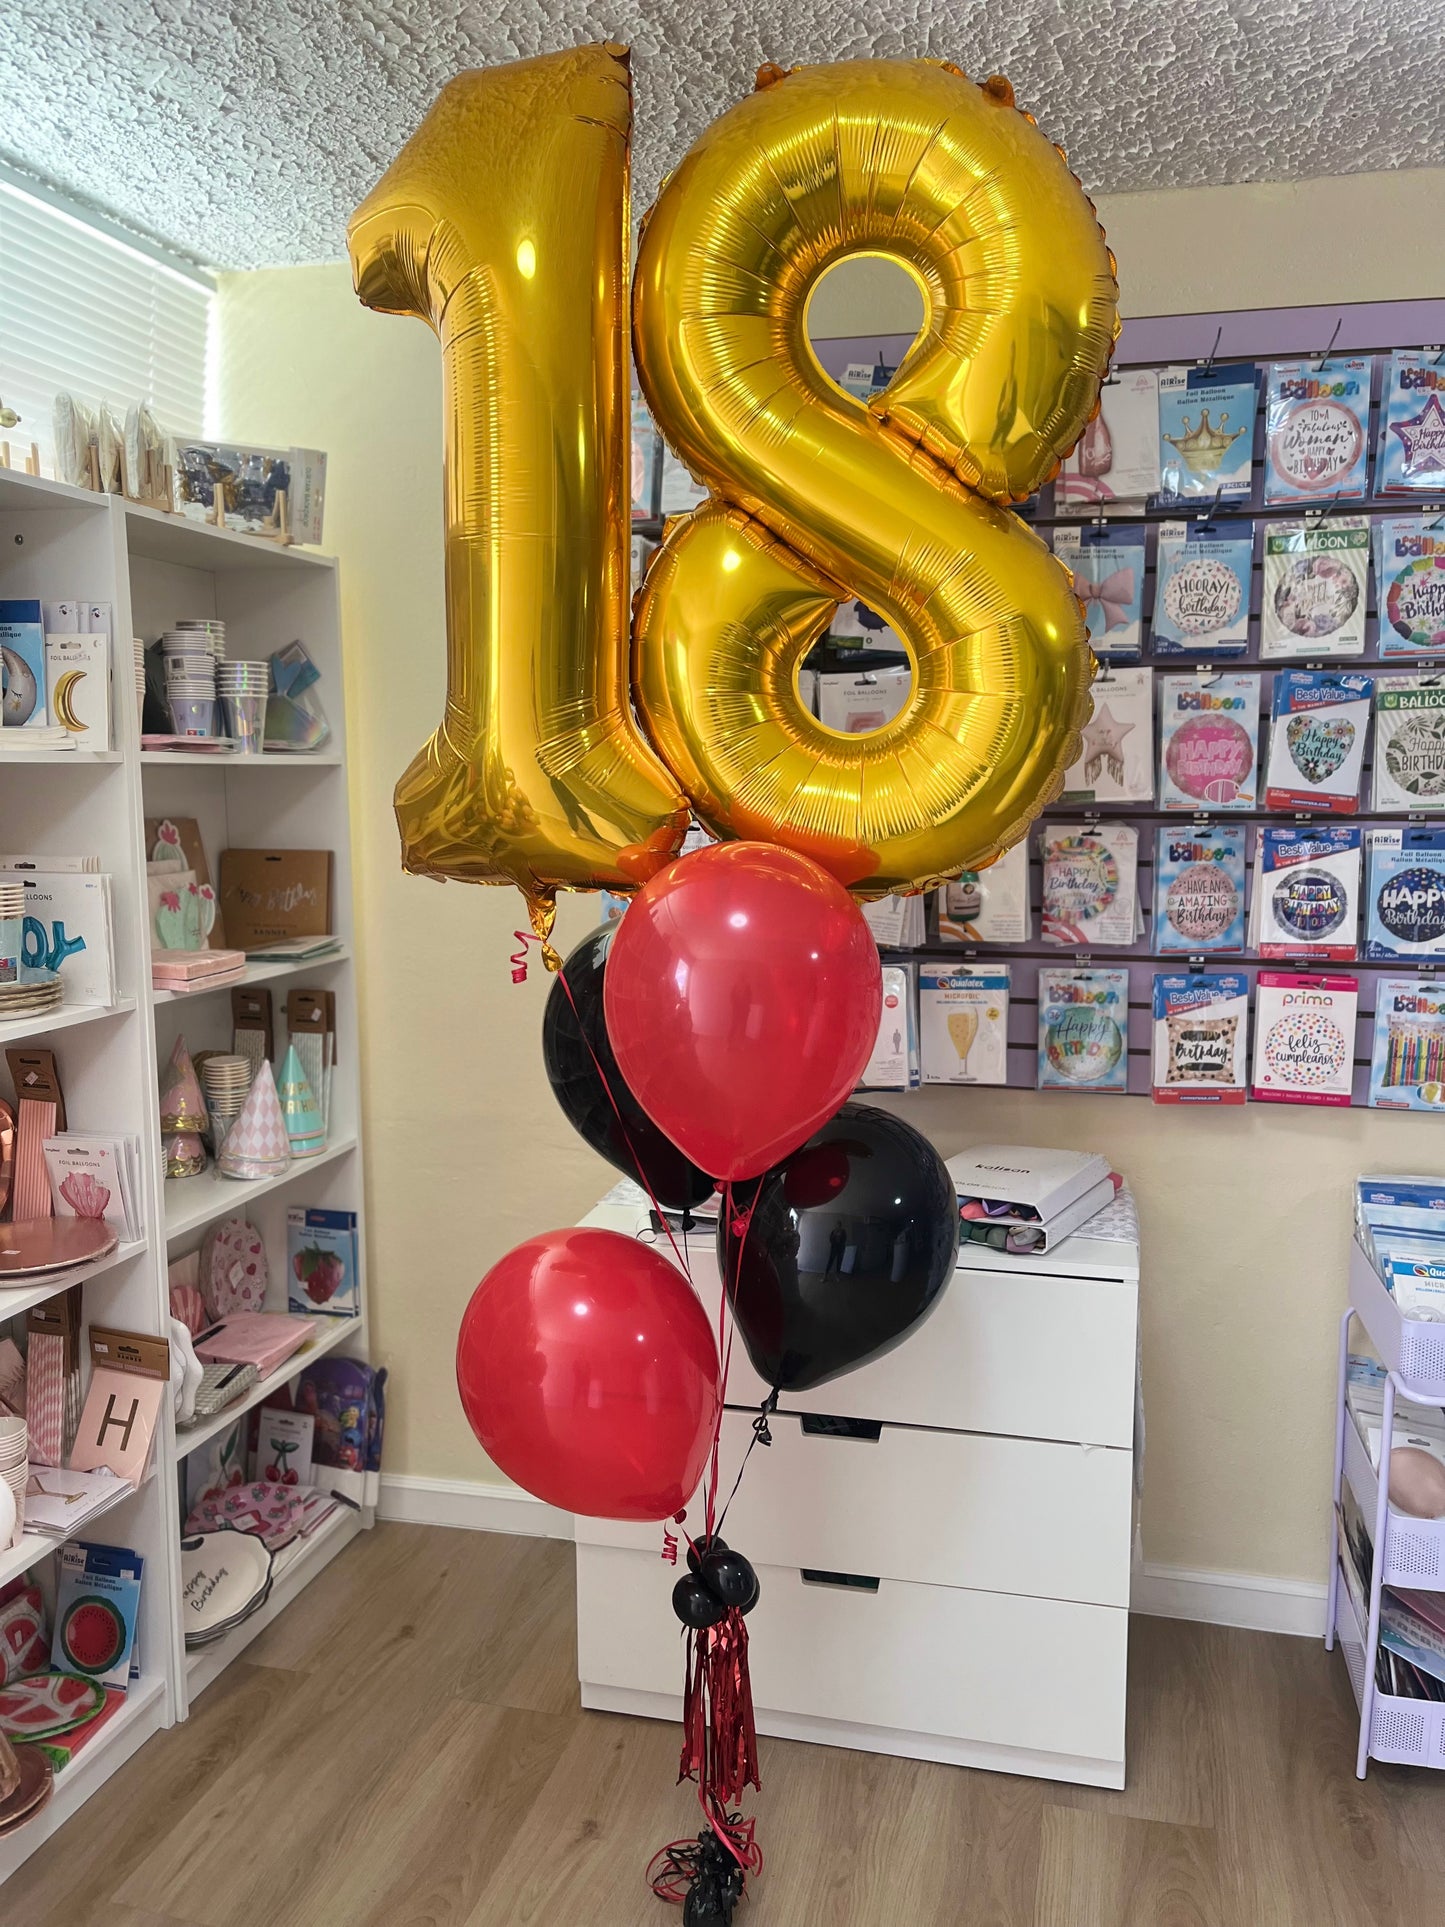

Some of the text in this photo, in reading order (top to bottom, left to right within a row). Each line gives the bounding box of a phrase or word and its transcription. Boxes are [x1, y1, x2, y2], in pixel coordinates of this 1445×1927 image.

[1200, 388, 1226, 396] Balloon
[1280, 379, 1360, 400] balloon
[1310, 409, 1330, 420] TO A
[1283, 431, 1350, 450] Woman
[1308, 446, 1326, 456] HAPPY
[1178, 579, 1230, 598] HOORAY!
[1179, 595, 1227, 619] birthday
[1177, 693, 1246, 710] balloon
[1296, 687, 1346, 700] Best Value
[1301, 728, 1339, 748] Happy
[1179, 739, 1245, 760] HAPPY
[1295, 743, 1342, 760] Birthday
[1177, 758, 1243, 776] BIRTHDAY
[1374, 835, 1400, 844] AiRise
[1279, 842, 1331, 856] Best Value
[1059, 867, 1091, 877] HAPPY
[1049, 877, 1100, 893] Birthday
[1187, 879, 1221, 894] HAVE AN
[1291, 884, 1331, 899] HAPPY
[25, 893, 53, 901] LLOONS
[1178, 894, 1227, 908] AMAZING
[1284, 898, 1340, 915] BIRTHDAY
[1176, 906, 1230, 927] Birthday!
[950, 978, 985, 988] Qualatex
[944, 992, 979, 1000] MICROFOIL
[1049, 985, 1120, 1004] balloon
[1171, 992, 1193, 1004] Best
[1282, 991, 1333, 1007] prima
[1056, 1015, 1107, 1042] Happy
[1283, 1034, 1330, 1054] feliz
[1175, 1041, 1229, 1064] Birthday
[1275, 1050, 1334, 1067] cumpleaños
[975, 1164, 1031, 1174] kalisan
[96, 1393, 140, 1452] H
